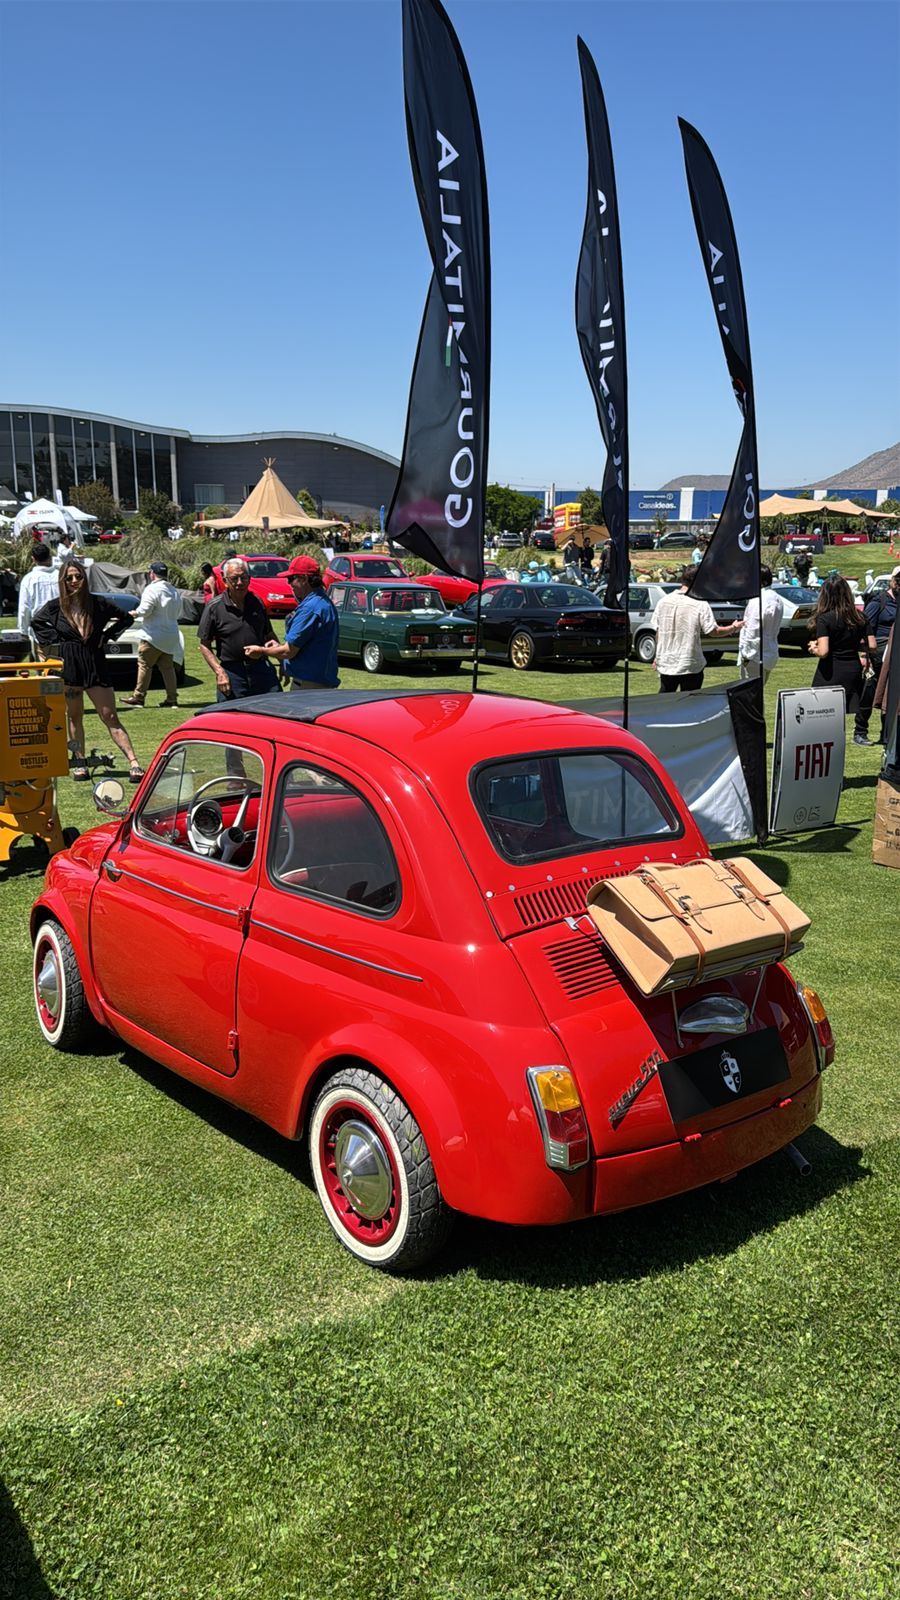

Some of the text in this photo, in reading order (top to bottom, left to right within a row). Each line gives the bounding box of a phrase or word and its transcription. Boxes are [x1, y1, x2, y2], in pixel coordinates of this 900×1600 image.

[9, 698, 32, 708] QUILL
[9, 708, 37, 717] FALCON
[10, 724, 39, 733] SYSTEM
[794, 742, 834, 781] FIAT
